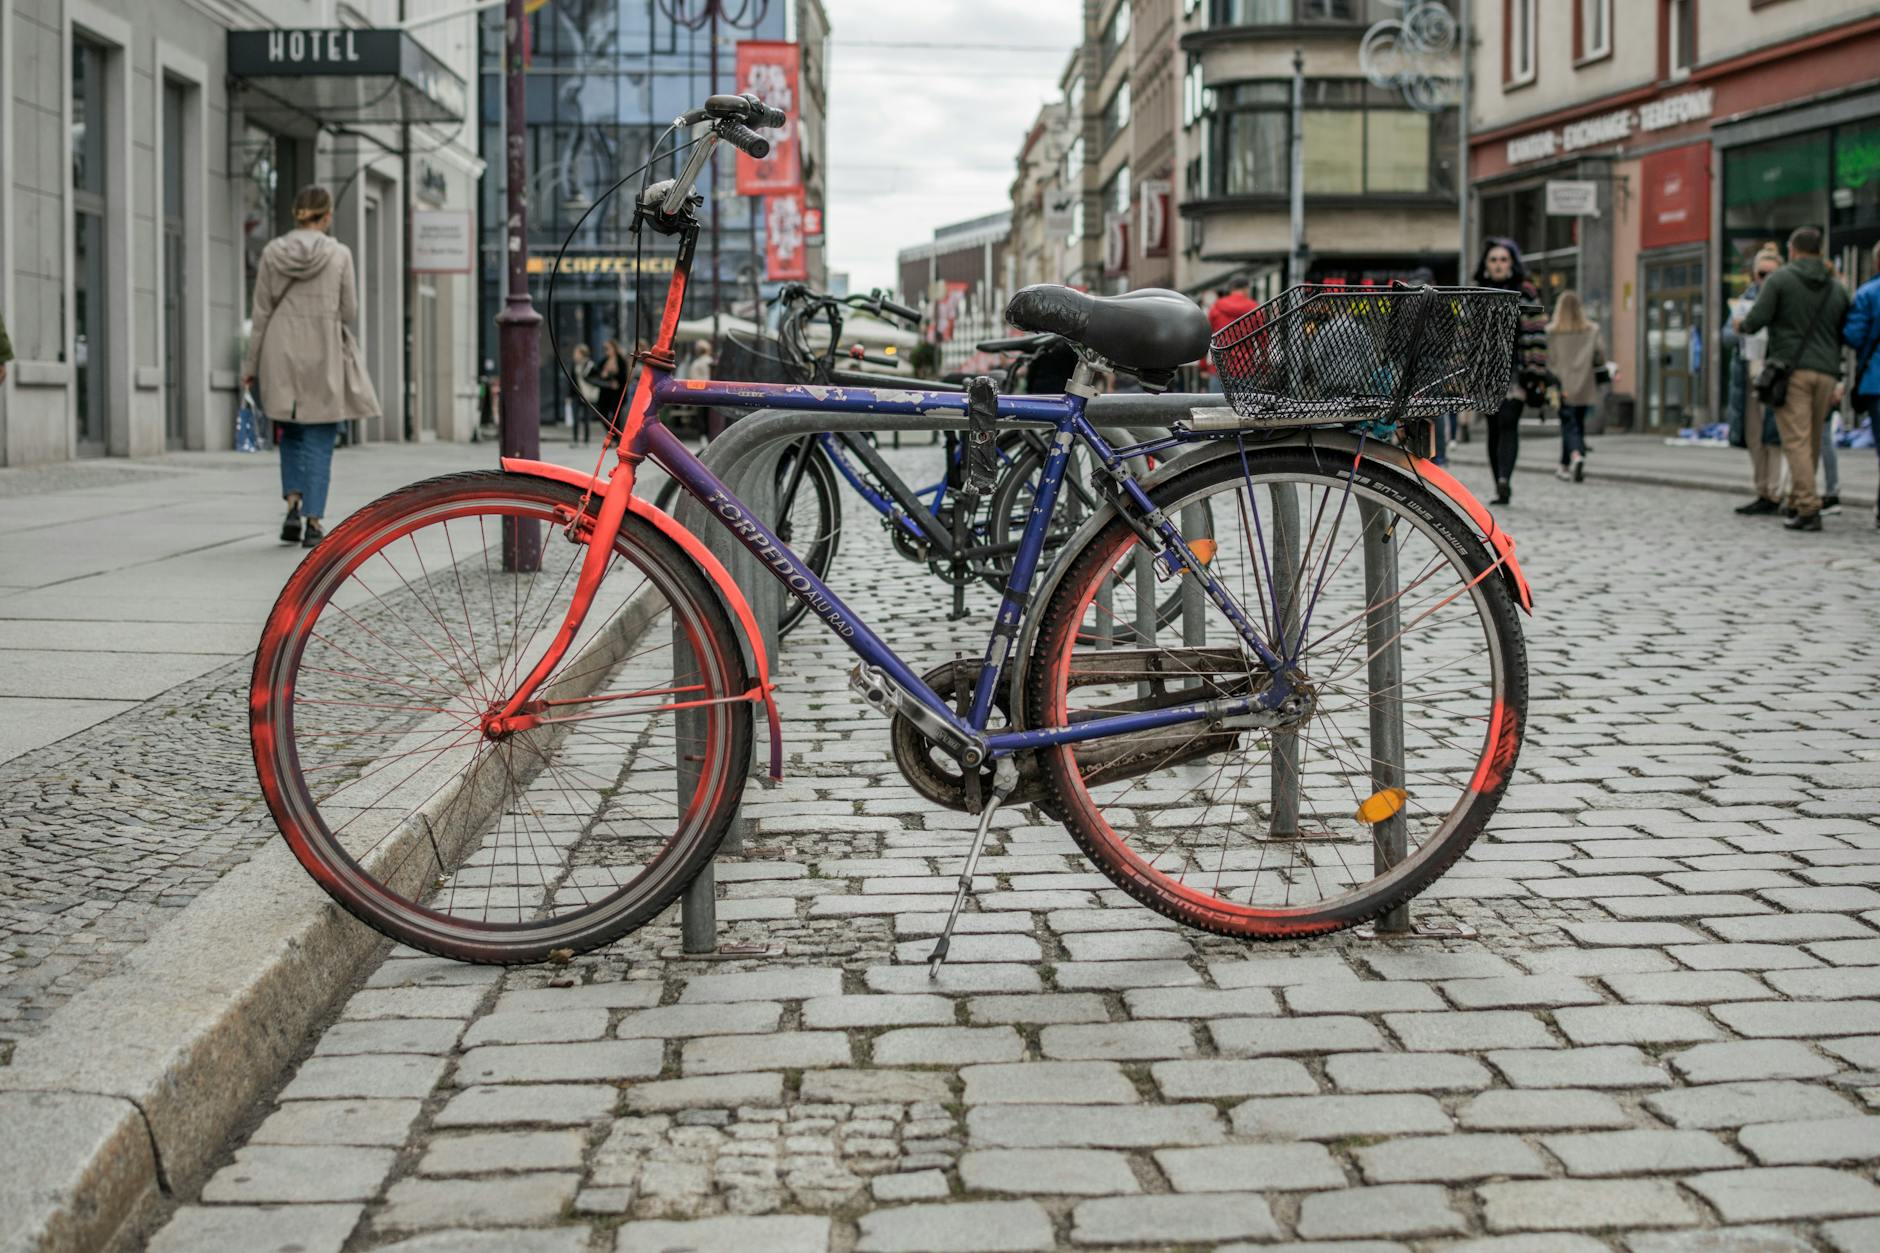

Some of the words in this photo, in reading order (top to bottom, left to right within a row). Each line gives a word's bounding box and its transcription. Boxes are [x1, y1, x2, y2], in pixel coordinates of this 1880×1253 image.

[268, 31, 360, 62] HOTEL
[1373, 481, 1407, 505] PLUS
[1408, 500, 1434, 521] SAM
[1433, 521, 1469, 556] SMART
[709, 489, 812, 592] TORPEDO
[803, 591, 831, 612] ALU
[827, 612, 855, 637] RAD
